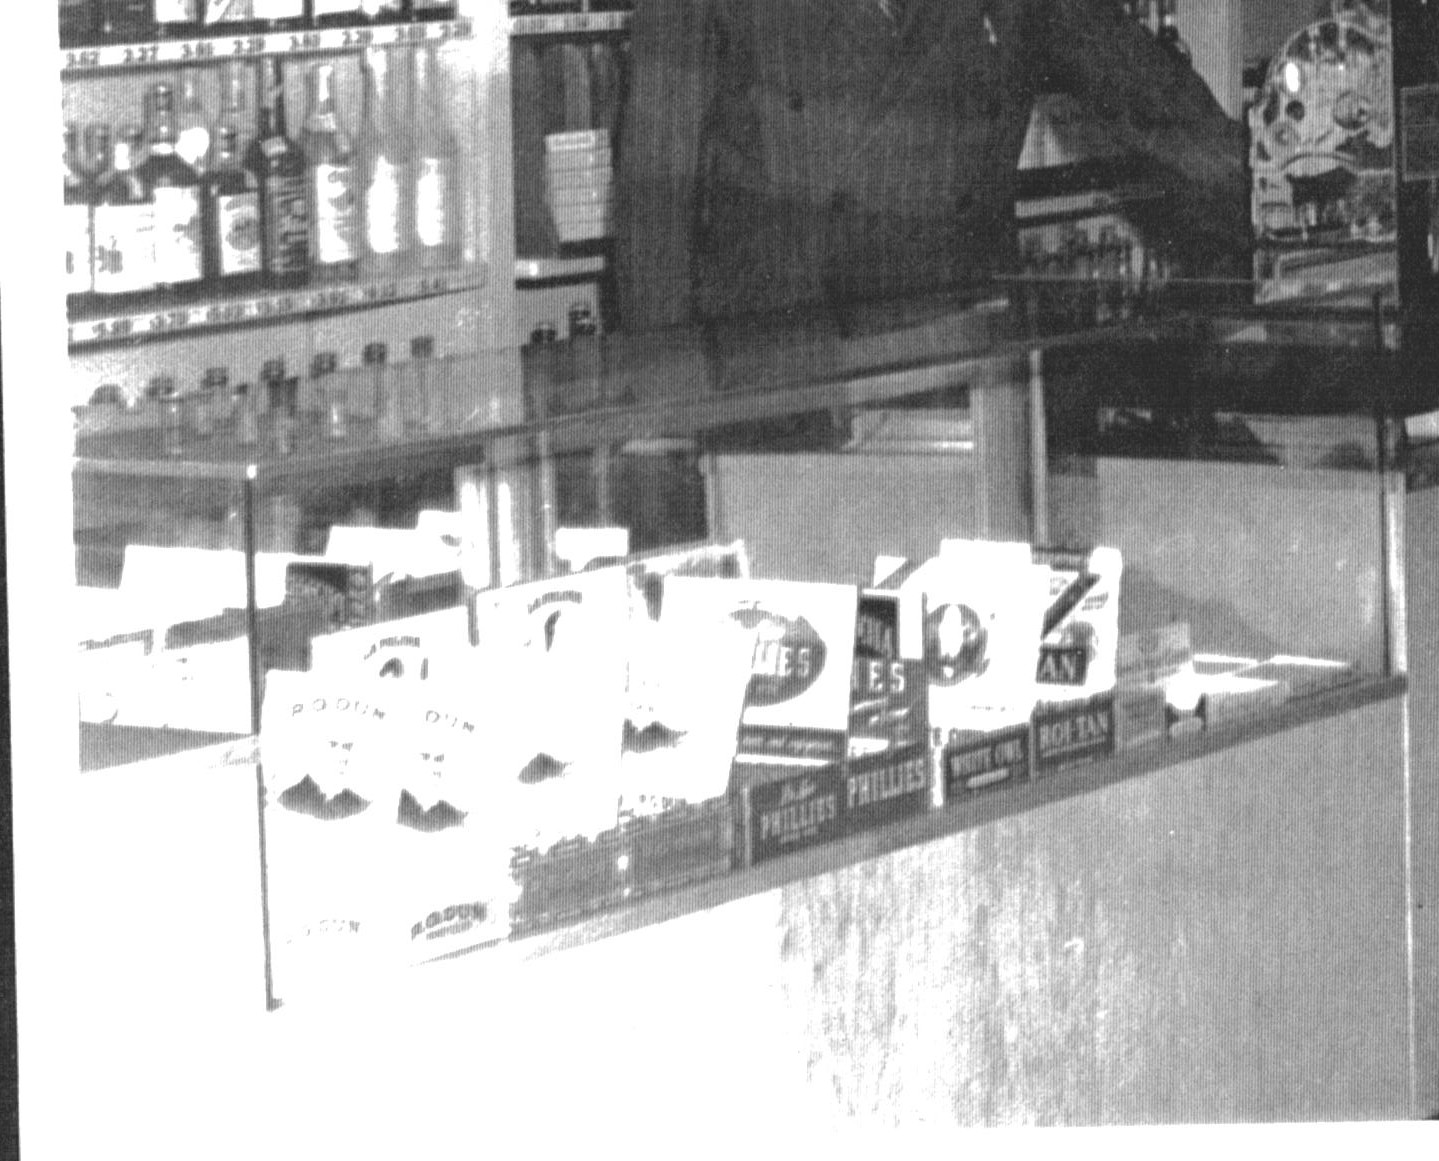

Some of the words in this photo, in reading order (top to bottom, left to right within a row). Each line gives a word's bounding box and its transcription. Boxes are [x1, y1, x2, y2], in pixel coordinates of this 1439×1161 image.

[1038, 711, 1110, 750] ROI-TAN
[848, 757, 927, 809] PHILLIES
[760, 794, 836, 840] PHILLIES
